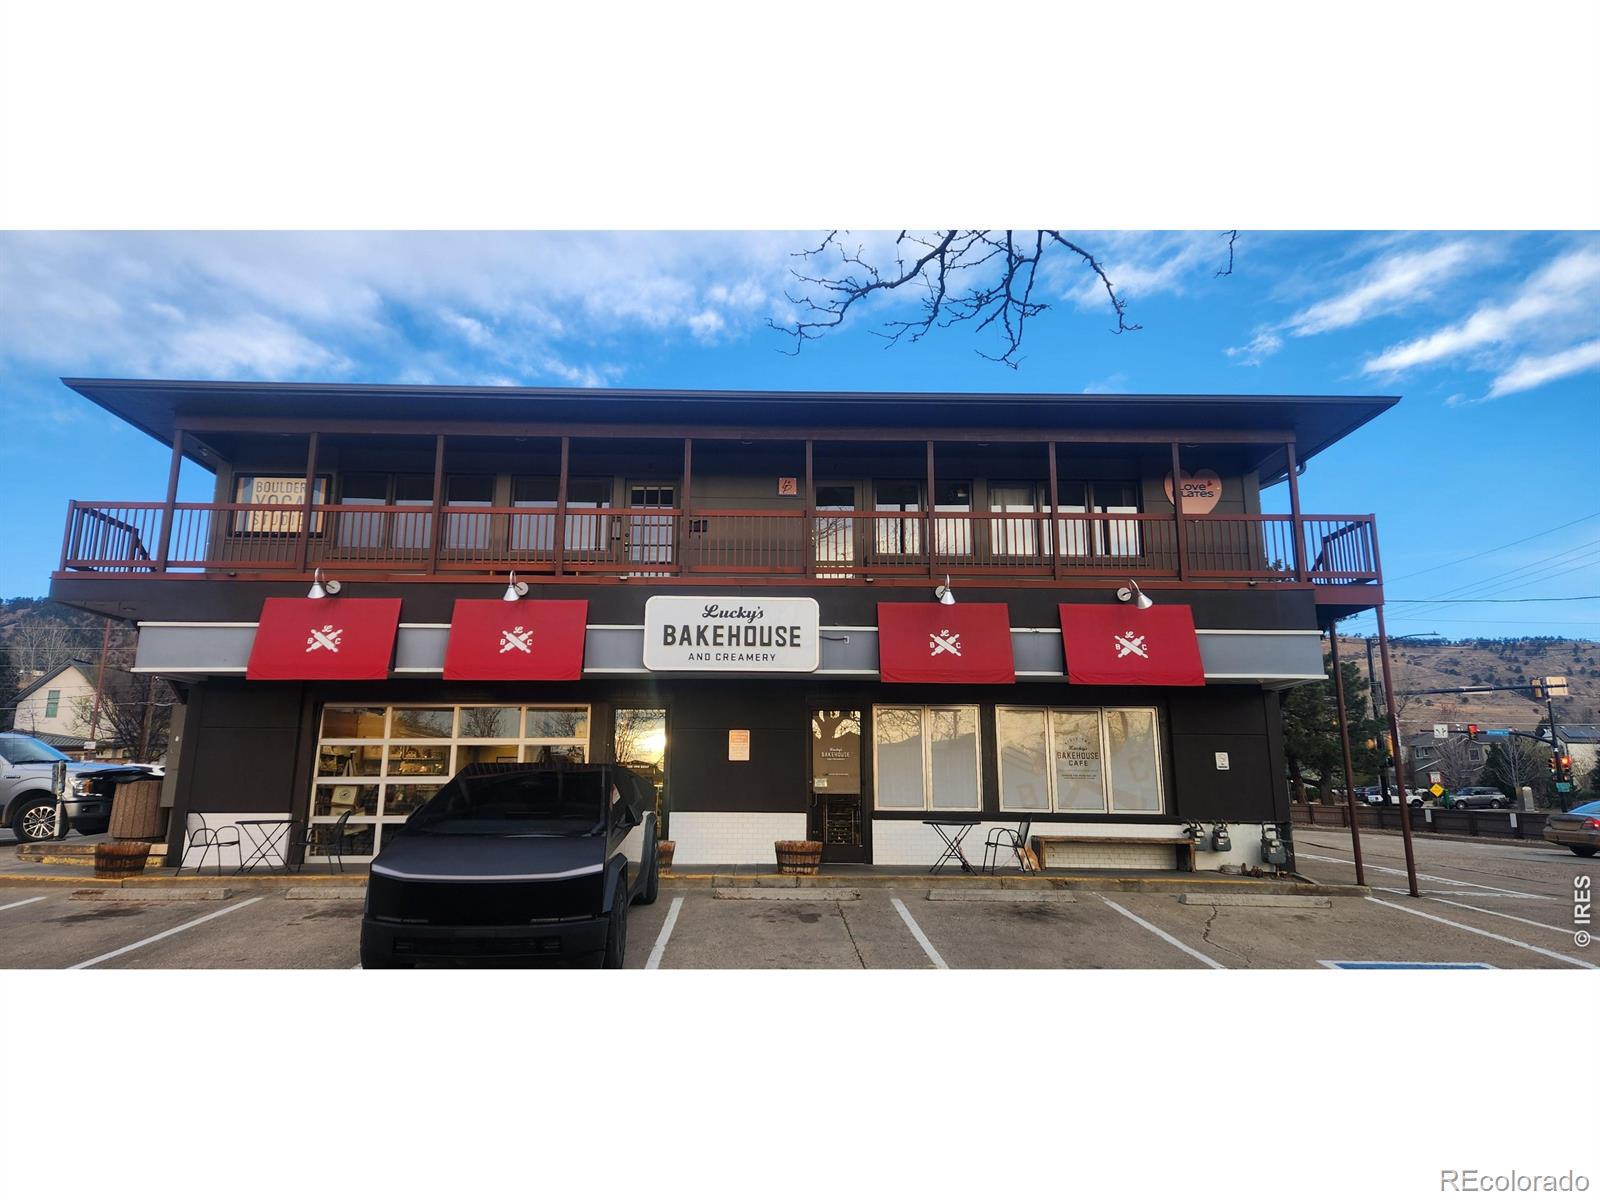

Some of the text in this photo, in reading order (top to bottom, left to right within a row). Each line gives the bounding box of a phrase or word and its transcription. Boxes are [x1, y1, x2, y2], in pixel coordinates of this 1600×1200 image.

[255, 481, 306, 493] BOULDER
[702, 604, 764, 624] Lucky's
[663, 624, 801, 648] BAKEHOUSE
[688, 653, 776, 662] AND CREAMERY
[1056, 751, 1099, 760] BAKEHOUSE
